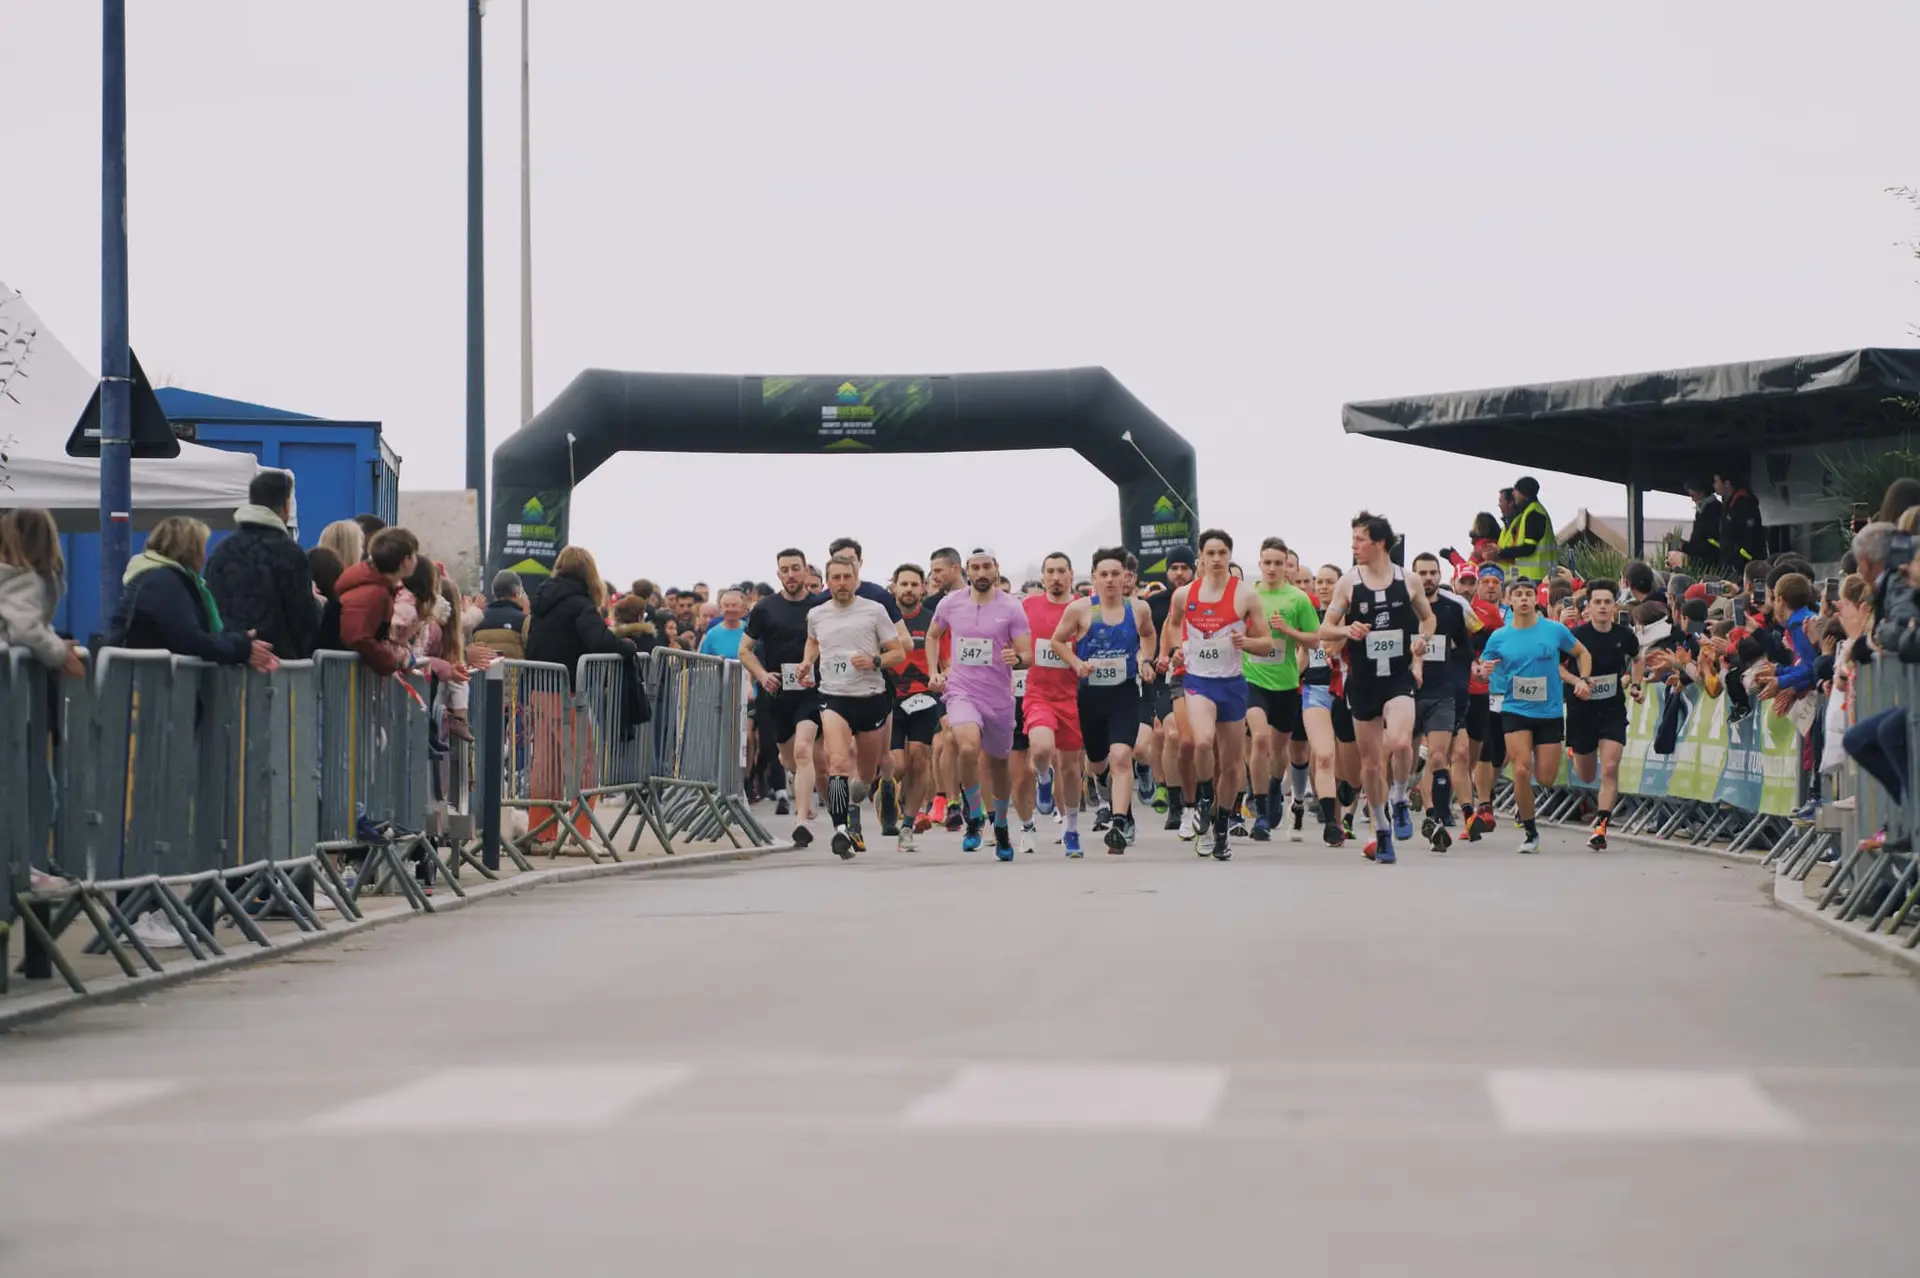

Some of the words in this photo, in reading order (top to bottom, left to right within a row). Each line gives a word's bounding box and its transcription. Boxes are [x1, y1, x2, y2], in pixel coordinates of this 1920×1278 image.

[1374, 640, 1394, 651] 289
[962, 648, 982, 659] 547
[1199, 649, 1219, 659] 468
[1314, 650, 1325, 660] 28
[834, 662, 847, 674] 79
[1096, 668, 1116, 678] 538
[1519, 686, 1538, 695] 467
